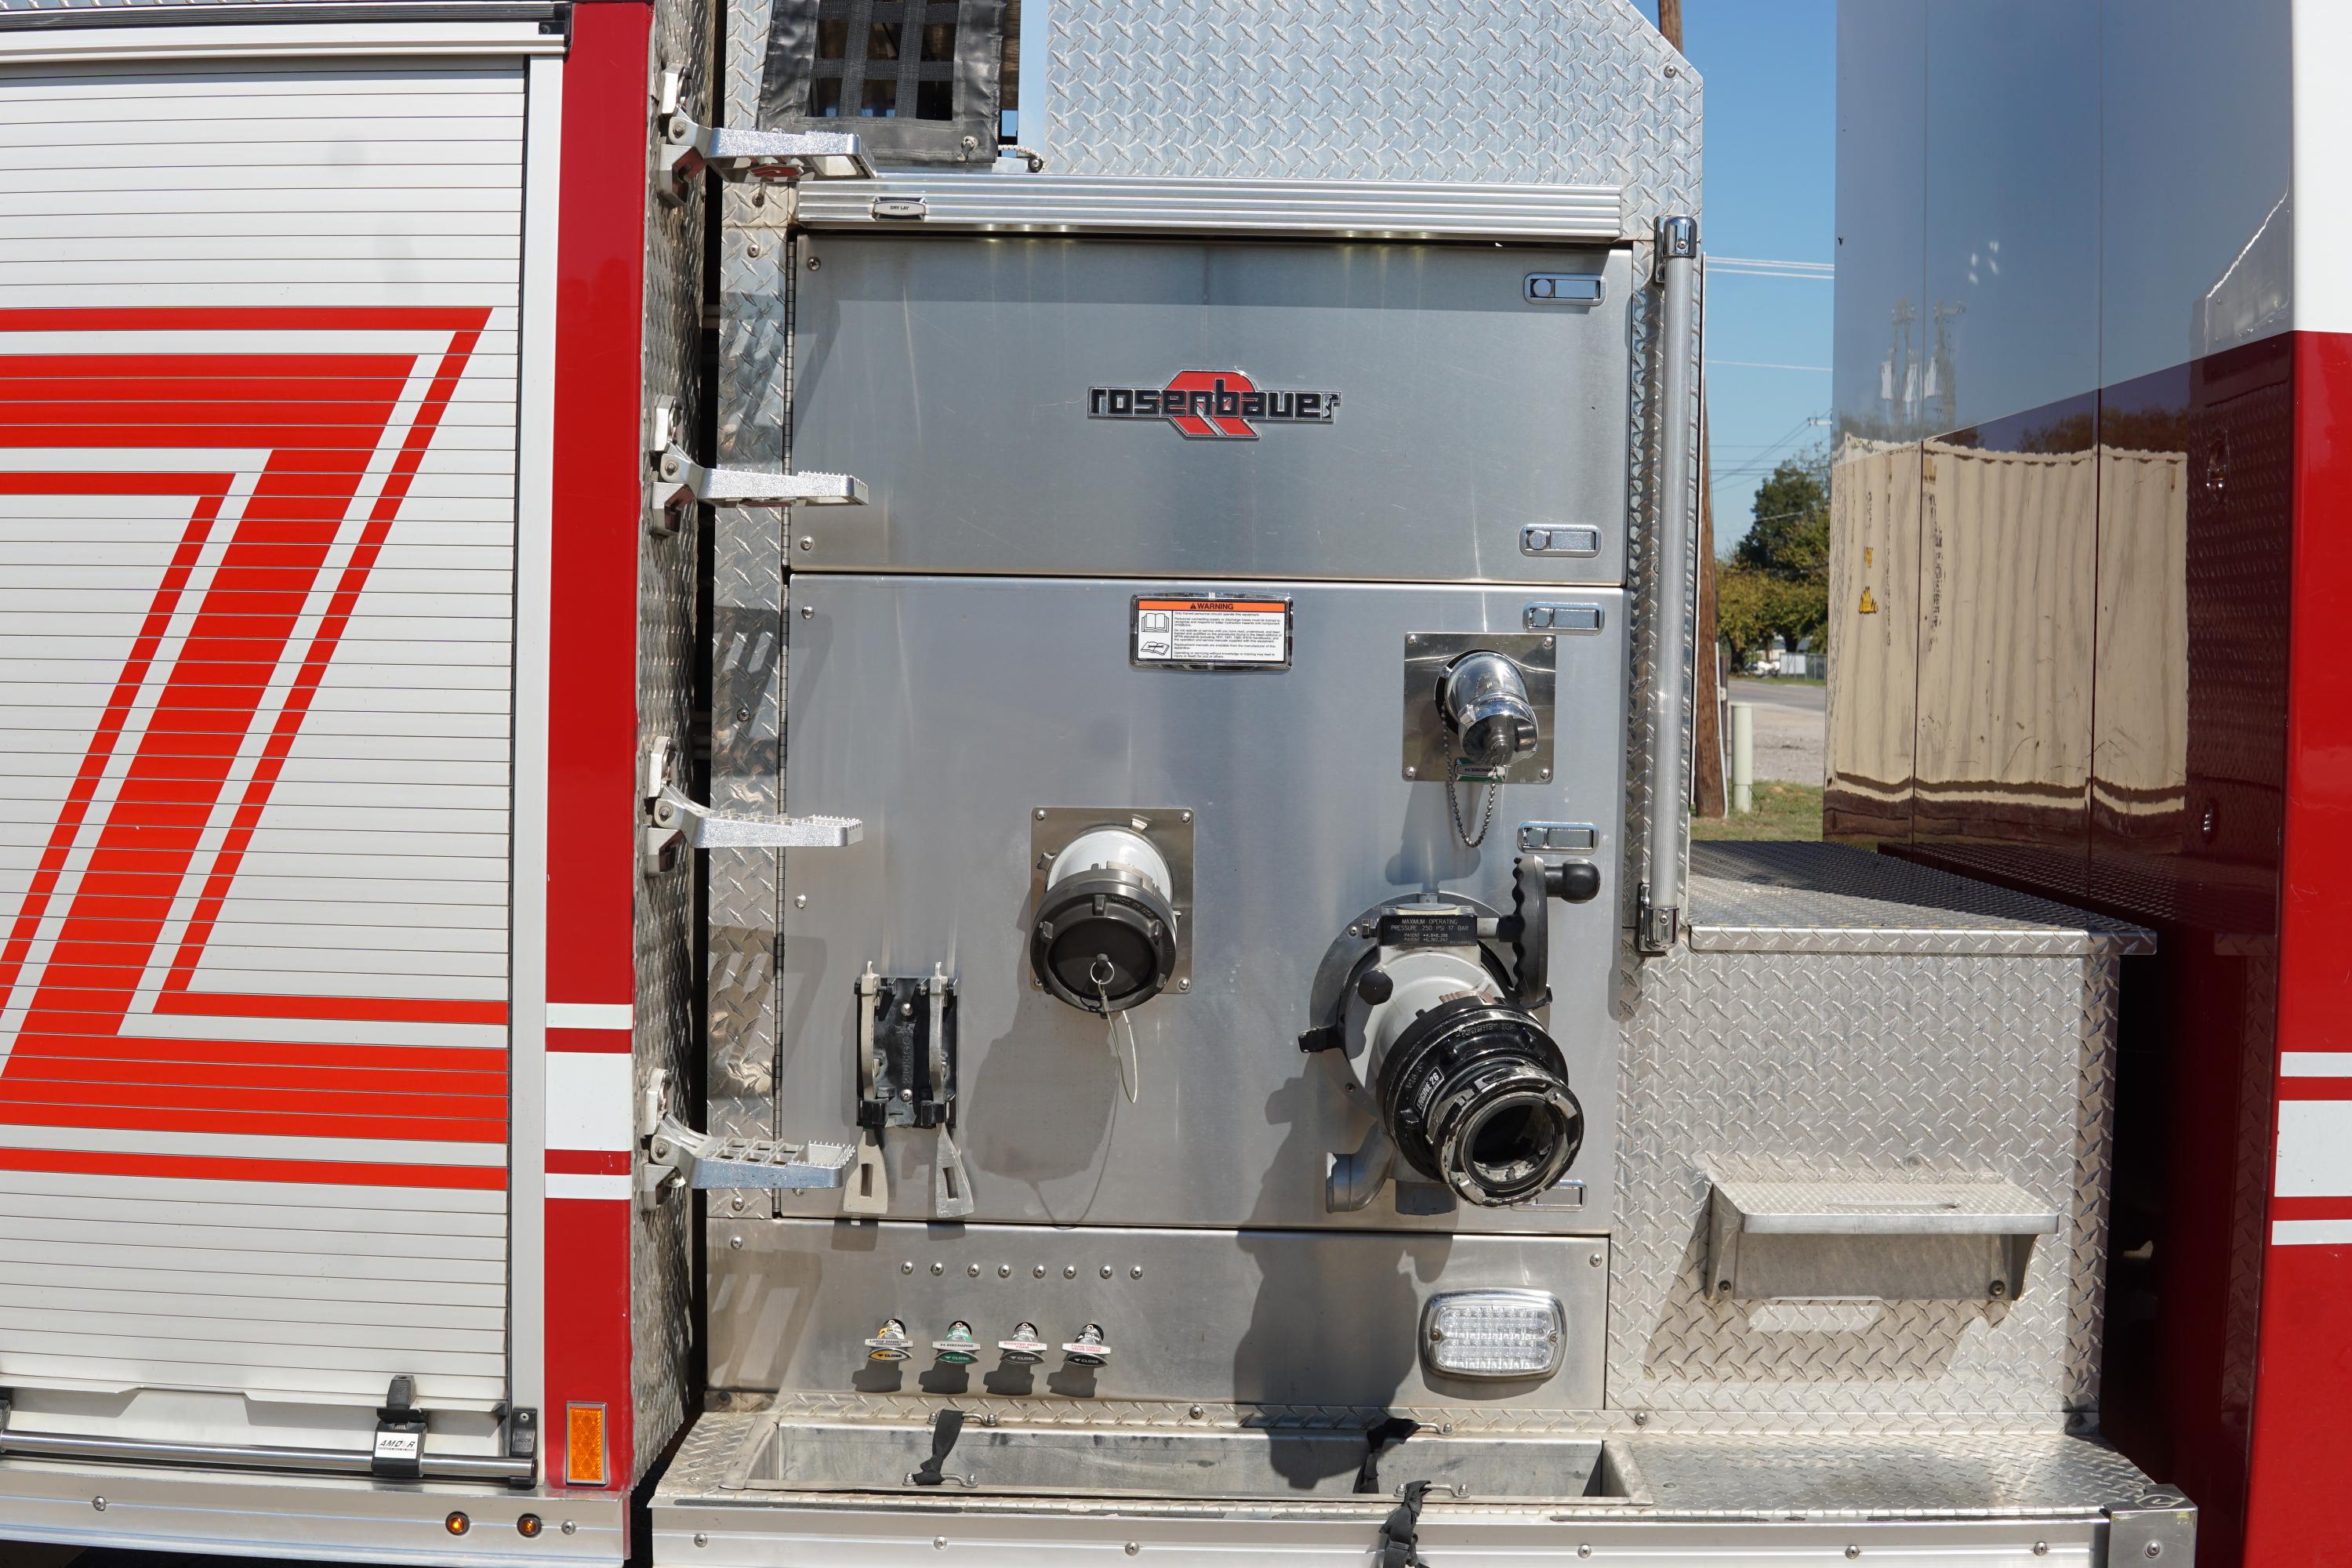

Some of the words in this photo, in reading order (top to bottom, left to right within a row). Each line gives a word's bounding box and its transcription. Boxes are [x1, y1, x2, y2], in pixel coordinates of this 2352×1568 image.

[1091, 379, 1338, 419] rosenbauer
[1417, 1082, 1432, 1110] ENGINE
[1429, 1072, 1439, 1085] 26
